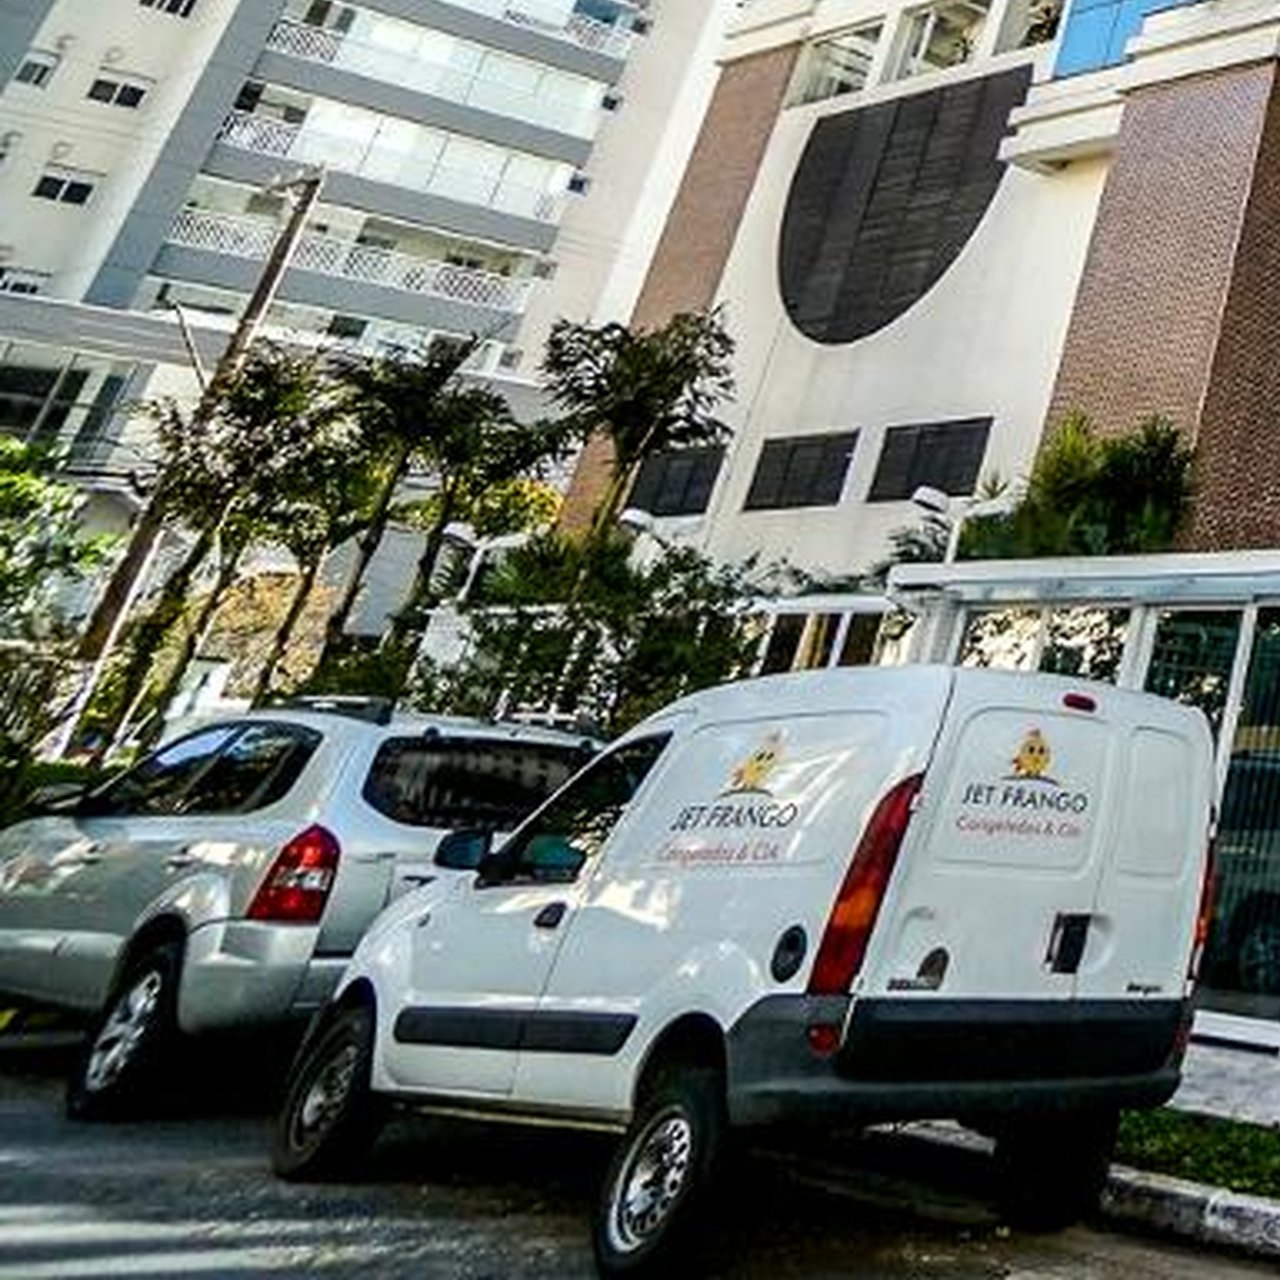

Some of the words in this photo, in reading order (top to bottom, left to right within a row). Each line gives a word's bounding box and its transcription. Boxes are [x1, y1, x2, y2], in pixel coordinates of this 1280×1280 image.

[962, 782, 996, 805] JET
[1001, 786, 1089, 814] FRANGO
[669, 805, 707, 831] JET
[706, 802, 798, 828] FRANGO
